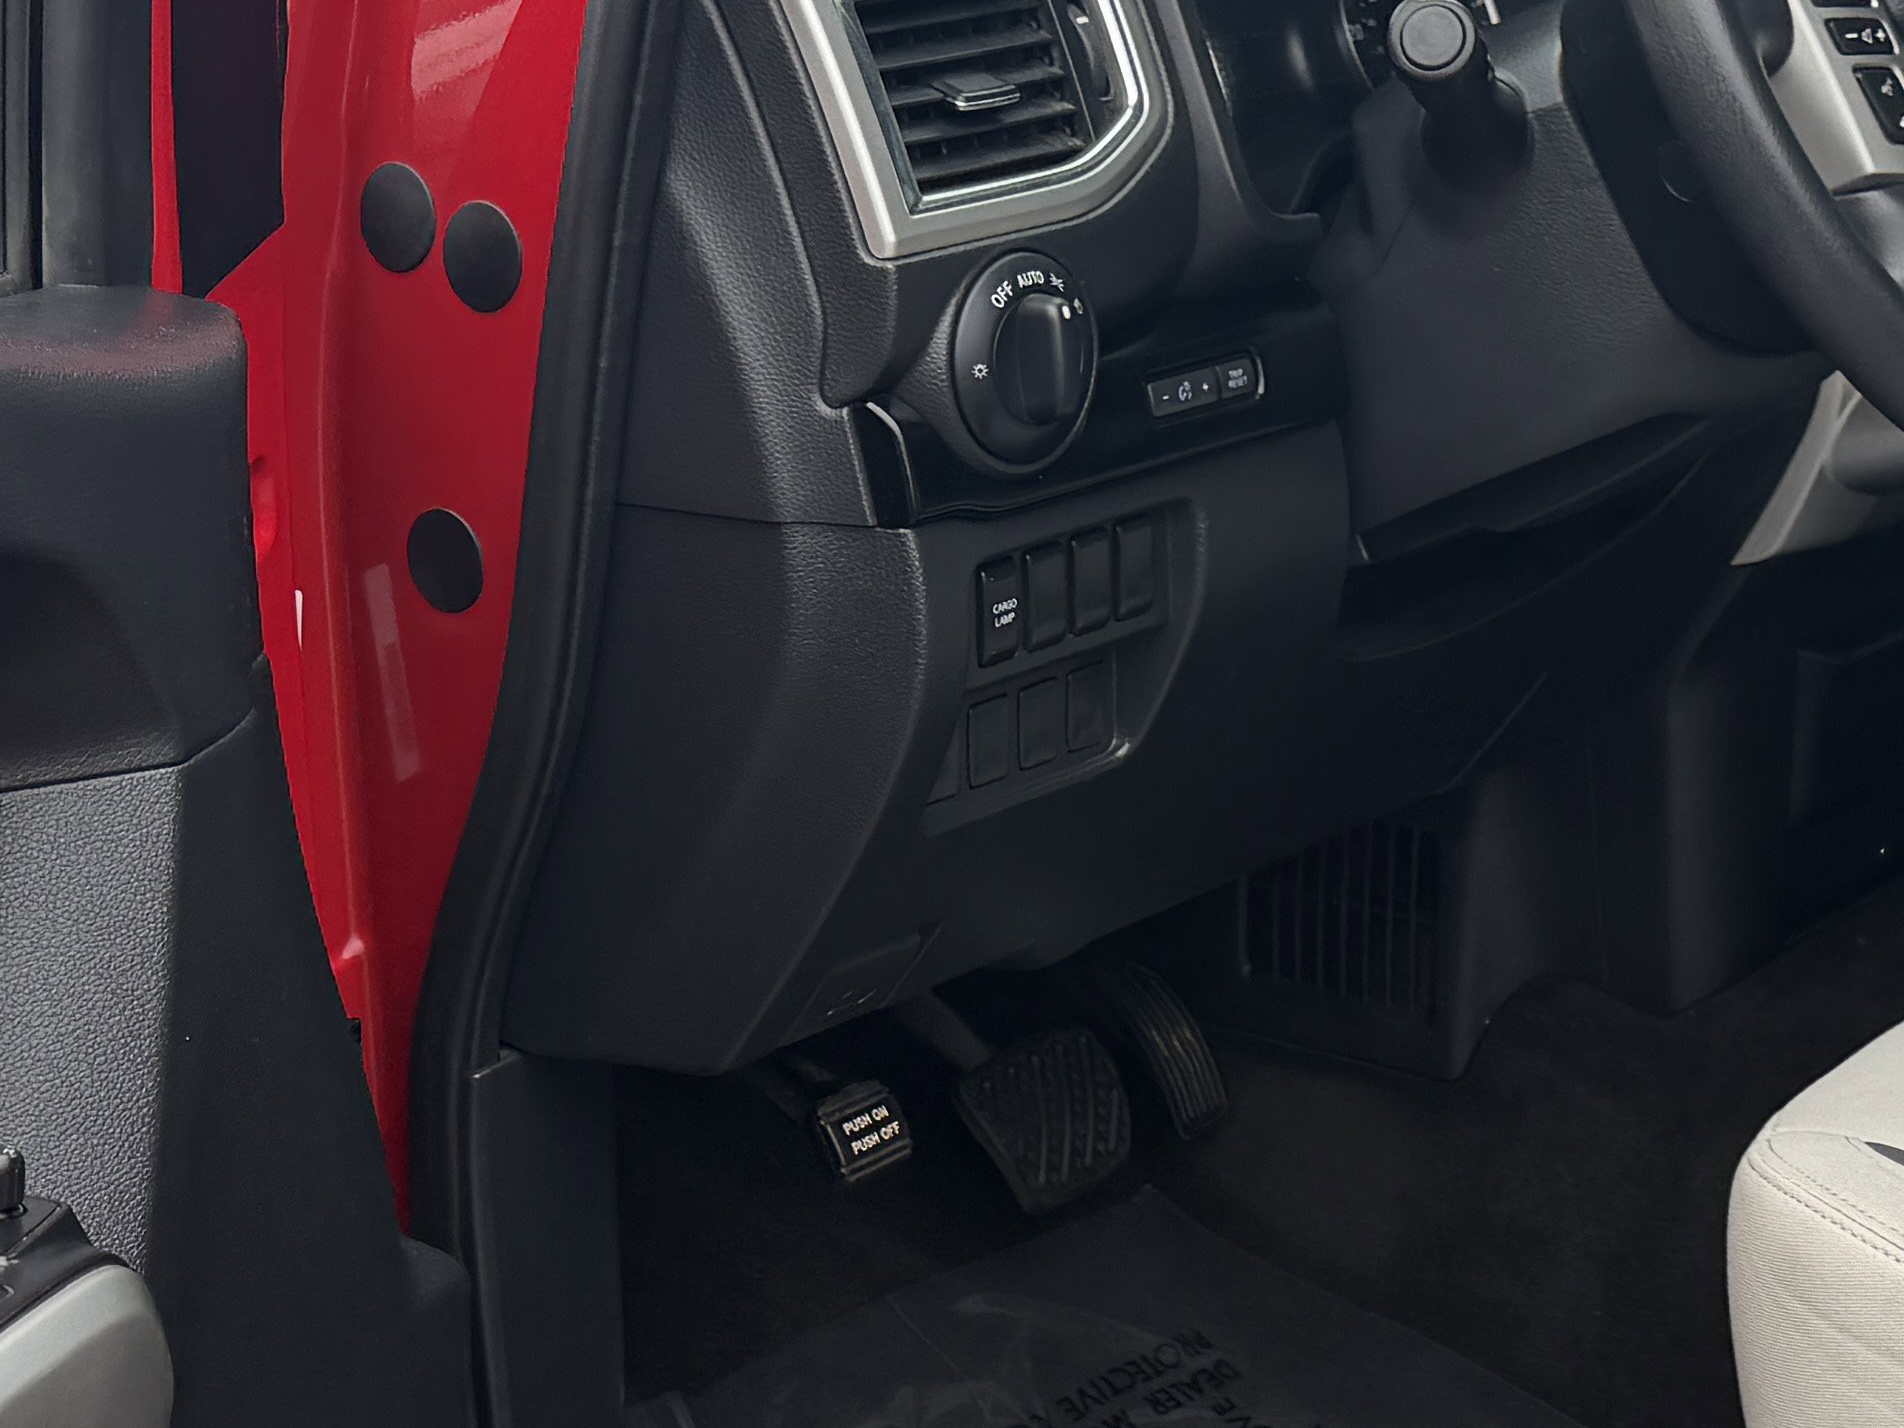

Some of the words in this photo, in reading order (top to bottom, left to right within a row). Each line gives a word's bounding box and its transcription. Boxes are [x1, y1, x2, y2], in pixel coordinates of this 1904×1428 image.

[990, 280, 1013, 309] OFF
[1017, 270, 1045, 289] AUTO
[992, 597, 1018, 615] CARGO
[994, 611, 1016, 628] LAMP
[842, 1112, 873, 1136] PUSH
[871, 1104, 890, 1121] ON
[850, 1131, 881, 1155] PUSH
[880, 1120, 900, 1140] OFF
[1054, 1327, 1215, 1423] PROTECTIVE
